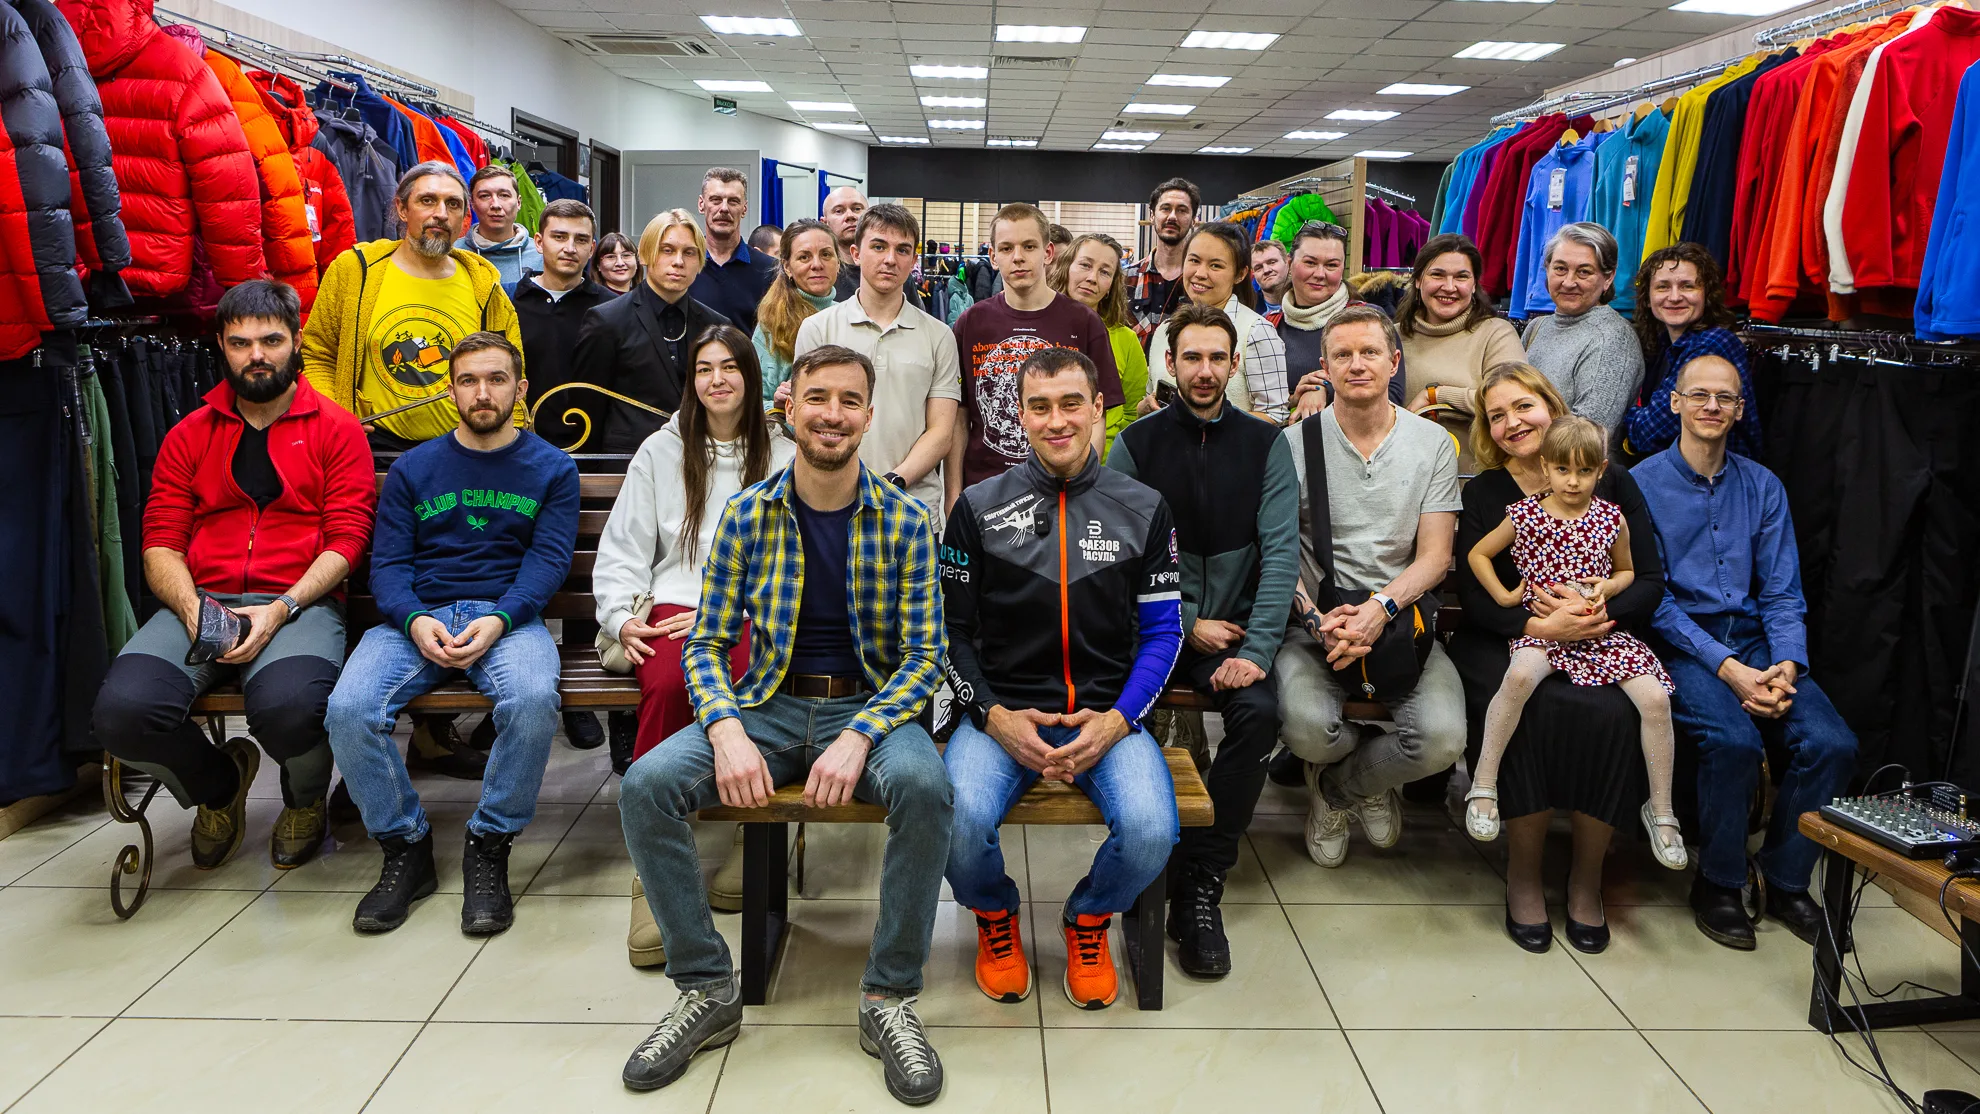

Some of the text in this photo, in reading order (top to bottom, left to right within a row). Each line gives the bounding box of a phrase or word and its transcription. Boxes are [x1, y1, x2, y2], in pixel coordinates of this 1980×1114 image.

[378, 314, 399, 338] LIFE
[406, 309, 418, 317] IS
[973, 341, 998, 352] above
[972, 354, 986, 365] fall
[373, 342, 395, 386] AROUND
[400, 386, 423, 397] THE
[414, 492, 458, 521] CLUB
[1079, 538, 1120, 552] ФАЕЗОВ
[1082, 550, 1116, 562] РАСУЛЬ
